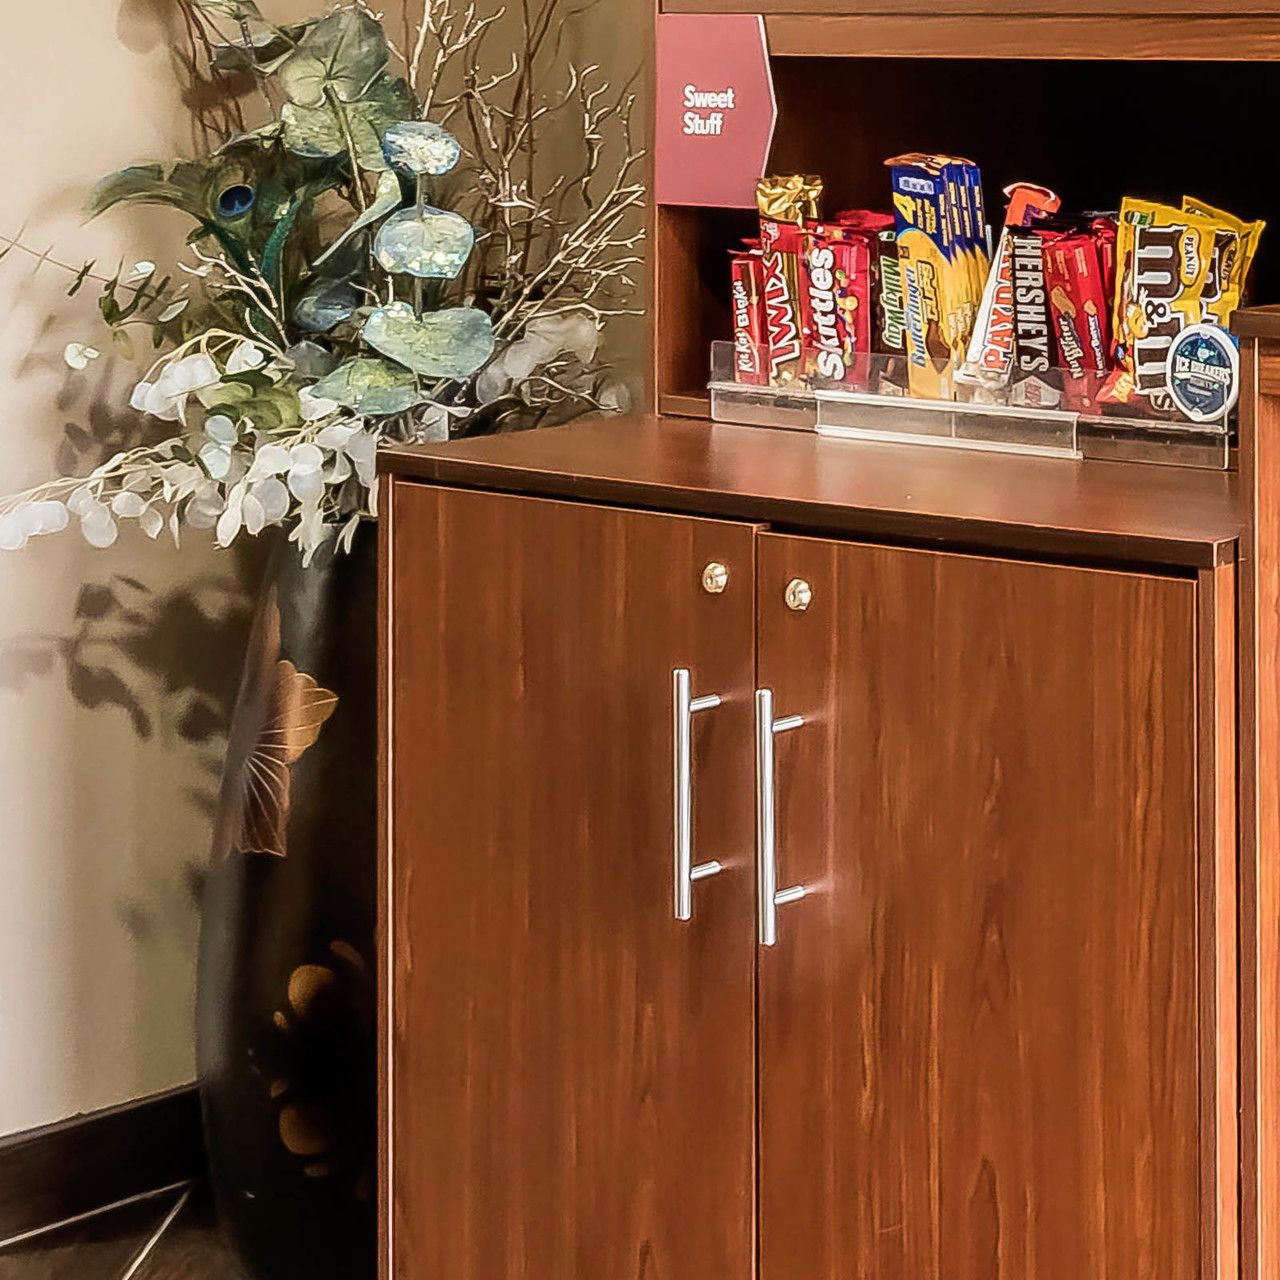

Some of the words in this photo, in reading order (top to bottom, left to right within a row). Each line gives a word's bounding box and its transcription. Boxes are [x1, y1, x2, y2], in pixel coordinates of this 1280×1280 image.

[683, 84, 735, 109] Sweet
[683, 112, 723, 135] Stuff
[1183, 235, 1196, 277] PEANUT
[809, 246, 845, 381] Skittles
[1013, 235, 1051, 373] HERSHEY'S
[1190, 361, 1230, 383] BREAKERS
